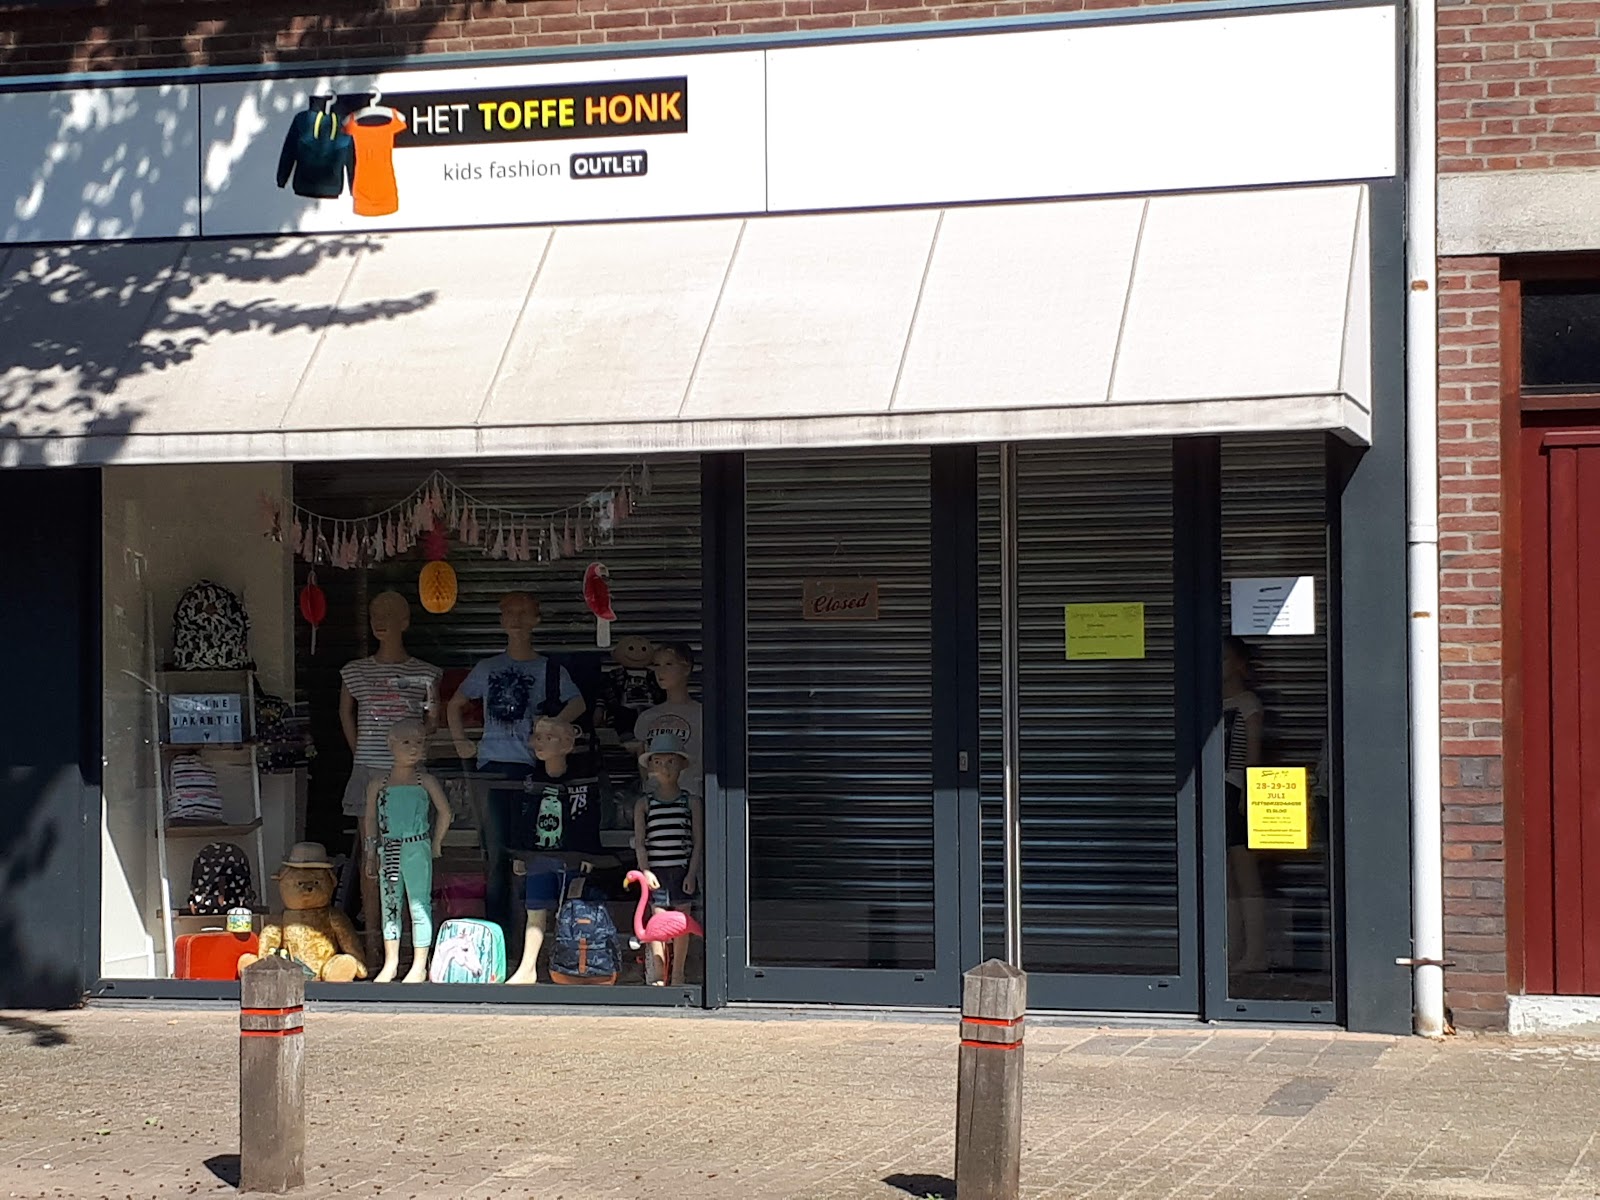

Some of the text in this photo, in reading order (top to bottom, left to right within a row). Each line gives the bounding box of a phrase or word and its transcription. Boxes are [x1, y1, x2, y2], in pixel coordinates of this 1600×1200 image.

[412, 92, 681, 135] HET TOFFE HONK
[444, 154, 643, 181] kids fashion OUTLET
[811, 592, 869, 613] Closed
[172, 715, 239, 726] VAKANTIE
[569, 793, 587, 815] 78
